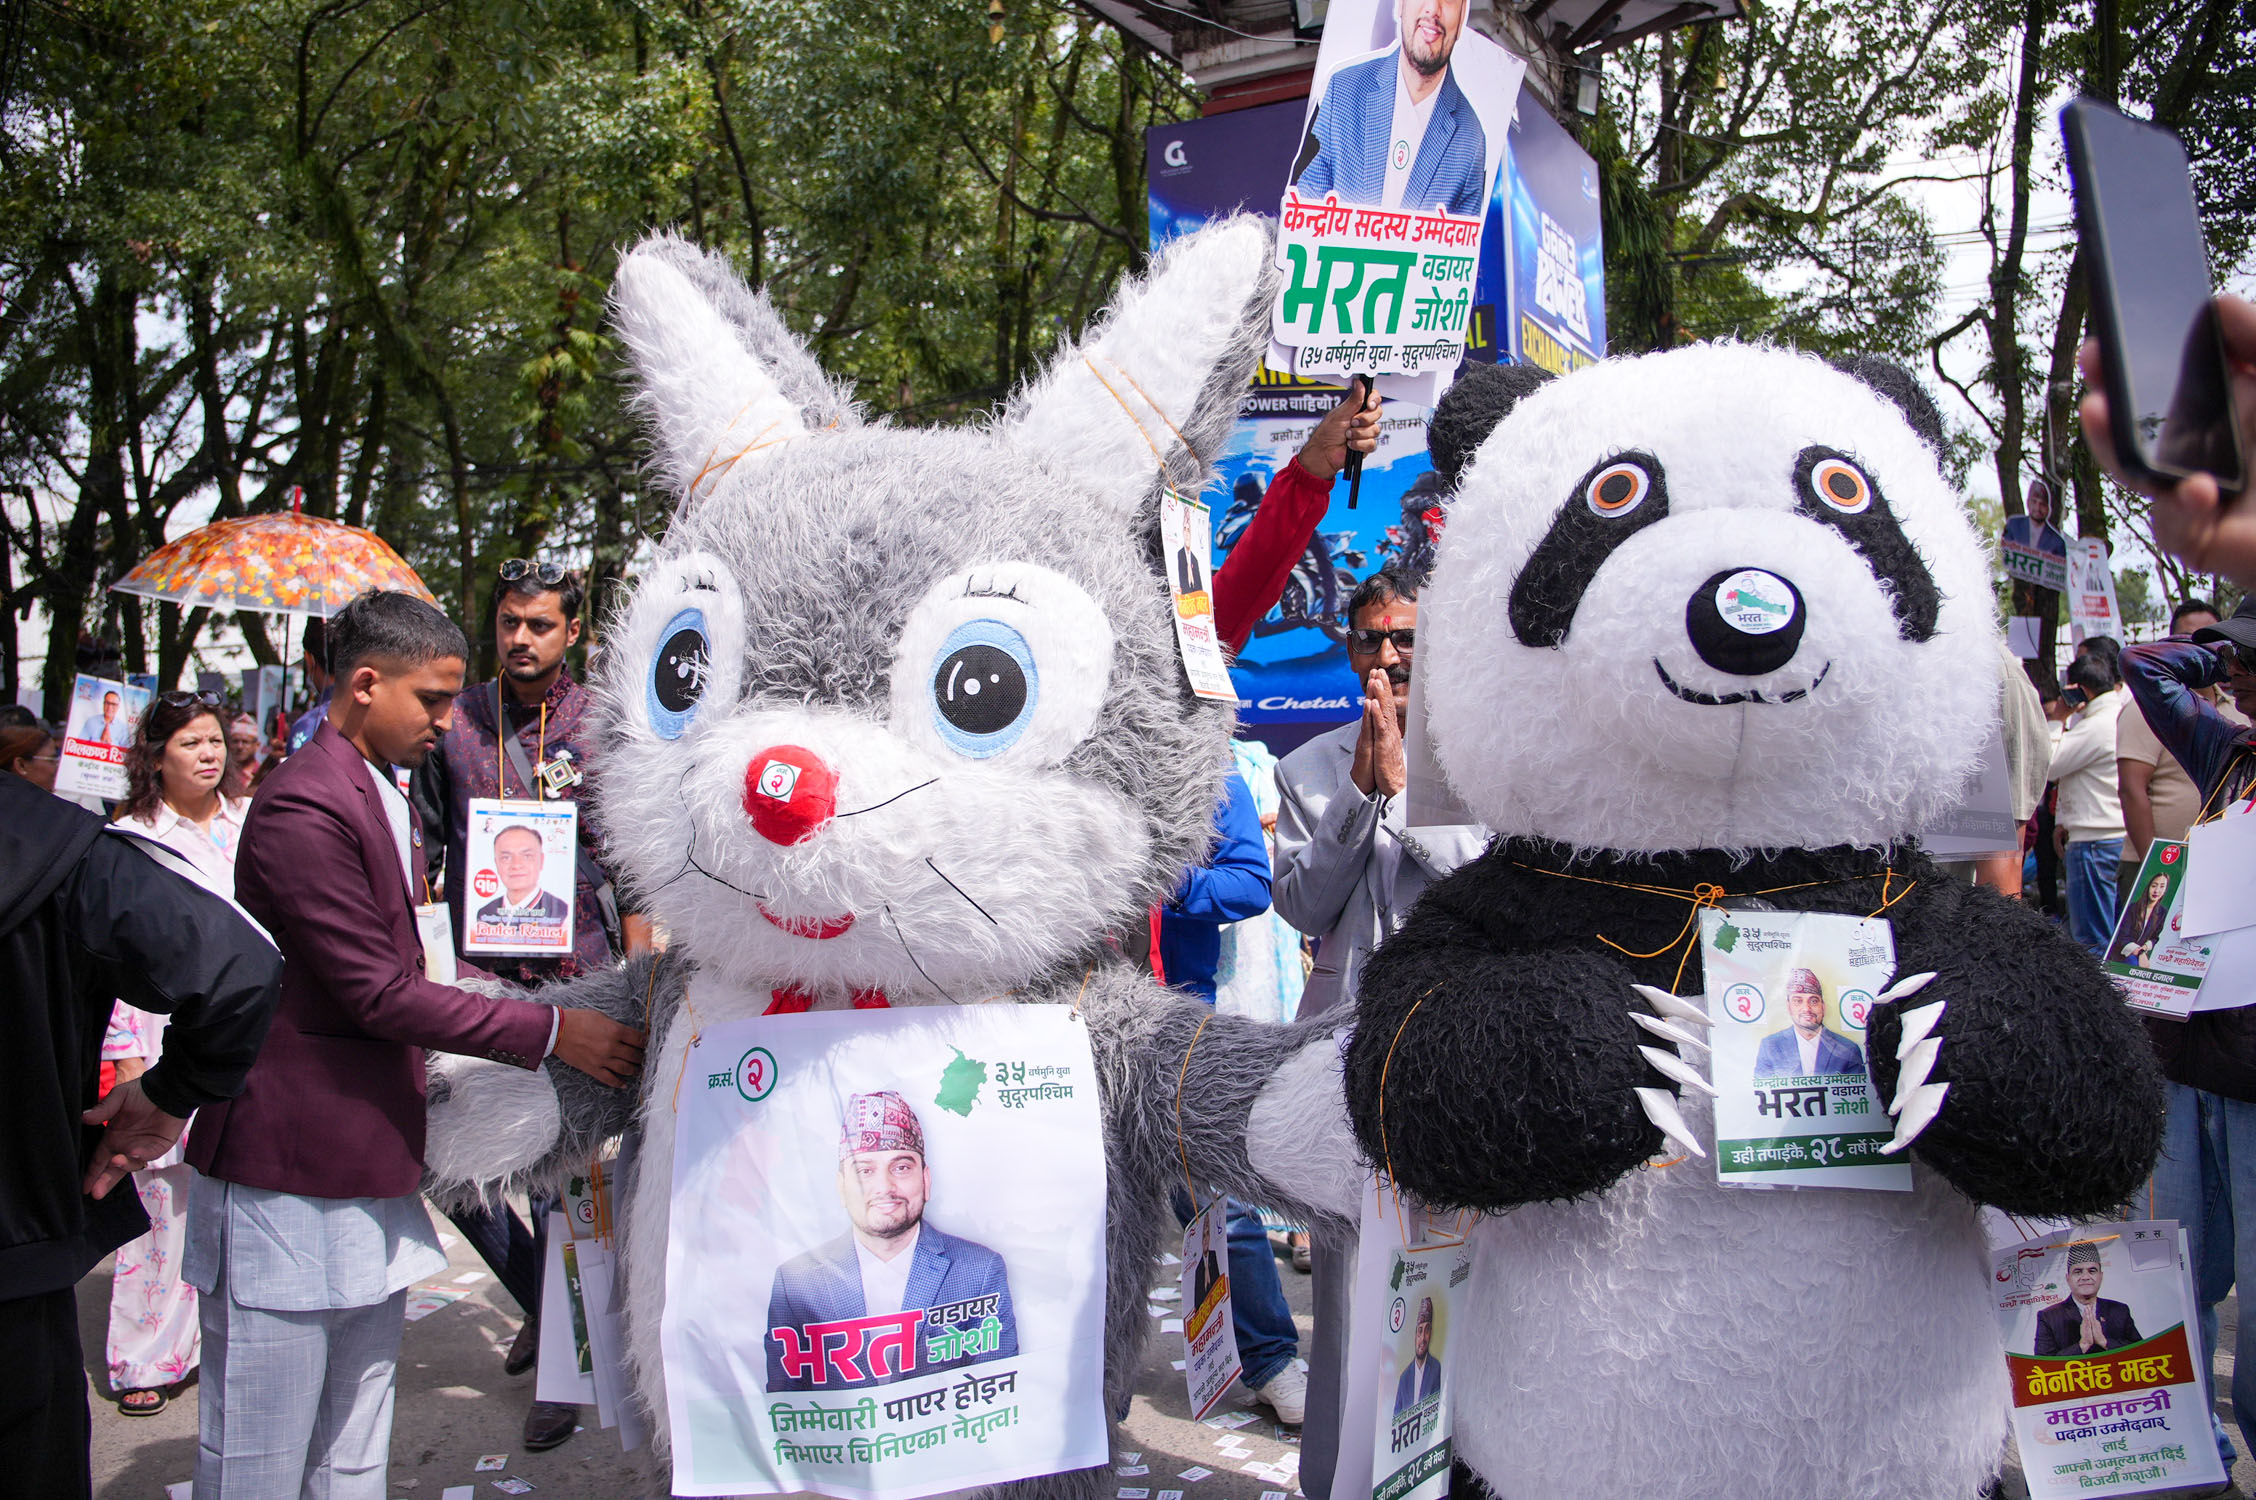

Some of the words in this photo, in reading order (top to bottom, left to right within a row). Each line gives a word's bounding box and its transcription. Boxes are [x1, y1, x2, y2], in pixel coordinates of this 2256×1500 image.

[1284, 192, 1352, 237] केन्द्रीय
[1354, 209, 1411, 242] सदस्य
[1414, 209, 1480, 247] उम्मेदवार
[1422, 253, 1474, 282] वडायर
[1283, 243, 1418, 334] भरत
[1535, 246, 1592, 343] POWER
[1411, 286, 1468, 332] जोशी
[1325, 340, 1366, 370] वर्षमुनि
[1369, 345, 1392, 368] युवा
[1270, 427, 1304, 443] असोज
[2003, 549, 2044, 576] भरत
[1737, 613, 1761, 623] भरत
[1257, 696, 1351, 710] Chetak
[771, 774, 784, 793] २
[1742, 927, 1760, 940] ३५
[1737, 996, 1751, 1017] २
[1852, 1003, 1866, 1024] २
[747, 1058, 764, 1092] २
[995, 1060, 1026, 1087] ३५
[1056, 1064, 1071, 1079] युवा
[1791, 1075, 1821, 1087] सदस्य
[1824, 1071, 1867, 1085] उम्मेदवार
[997, 1083, 1074, 1107] सुदूरपश्चिम
[1754, 1086, 1828, 1118] भरत
[1831, 1085, 1866, 1097] वडायर
[1832, 1097, 1870, 1115] जोशी
[1731, 1146, 1754, 1164] उही
[1809, 1137, 1845, 1165] २८
[584, 1207, 592, 1219] २
[928, 1293, 998, 1326] वडायर
[1394, 1309, 1401, 1327] २
[773, 1309, 923, 1385] भरत
[927, 1319, 1001, 1364] जोशी
[2026, 1360, 2113, 1396] नैनसिंह
[2118, 1354, 2175, 1383] महर
[768, 1398, 877, 1434] जिम्मेवारी
[884, 1386, 946, 1422] पाएर
[953, 1370, 1018, 1408] होइन
[2044, 1389, 2171, 1425] महामन्त्री
[773, 1438, 843, 1466] निभाएर
[848, 1425, 947, 1466] चिनिएका
[953, 1405, 1020, 1446] नेतृत्व!
[1391, 1411, 1422, 1453] भरत
[2055, 1425, 2097, 1442] पदका
[2100, 1416, 2171, 1435] उम्मेदवार
[2095, 1456, 2137, 1470] अमूल्य
[2139, 1451, 2159, 1463] मत
[2160, 1444, 2187, 1461] दिई
[2101, 1436, 2128, 1453] लाई
[1408, 1457, 1422, 1487] २८
